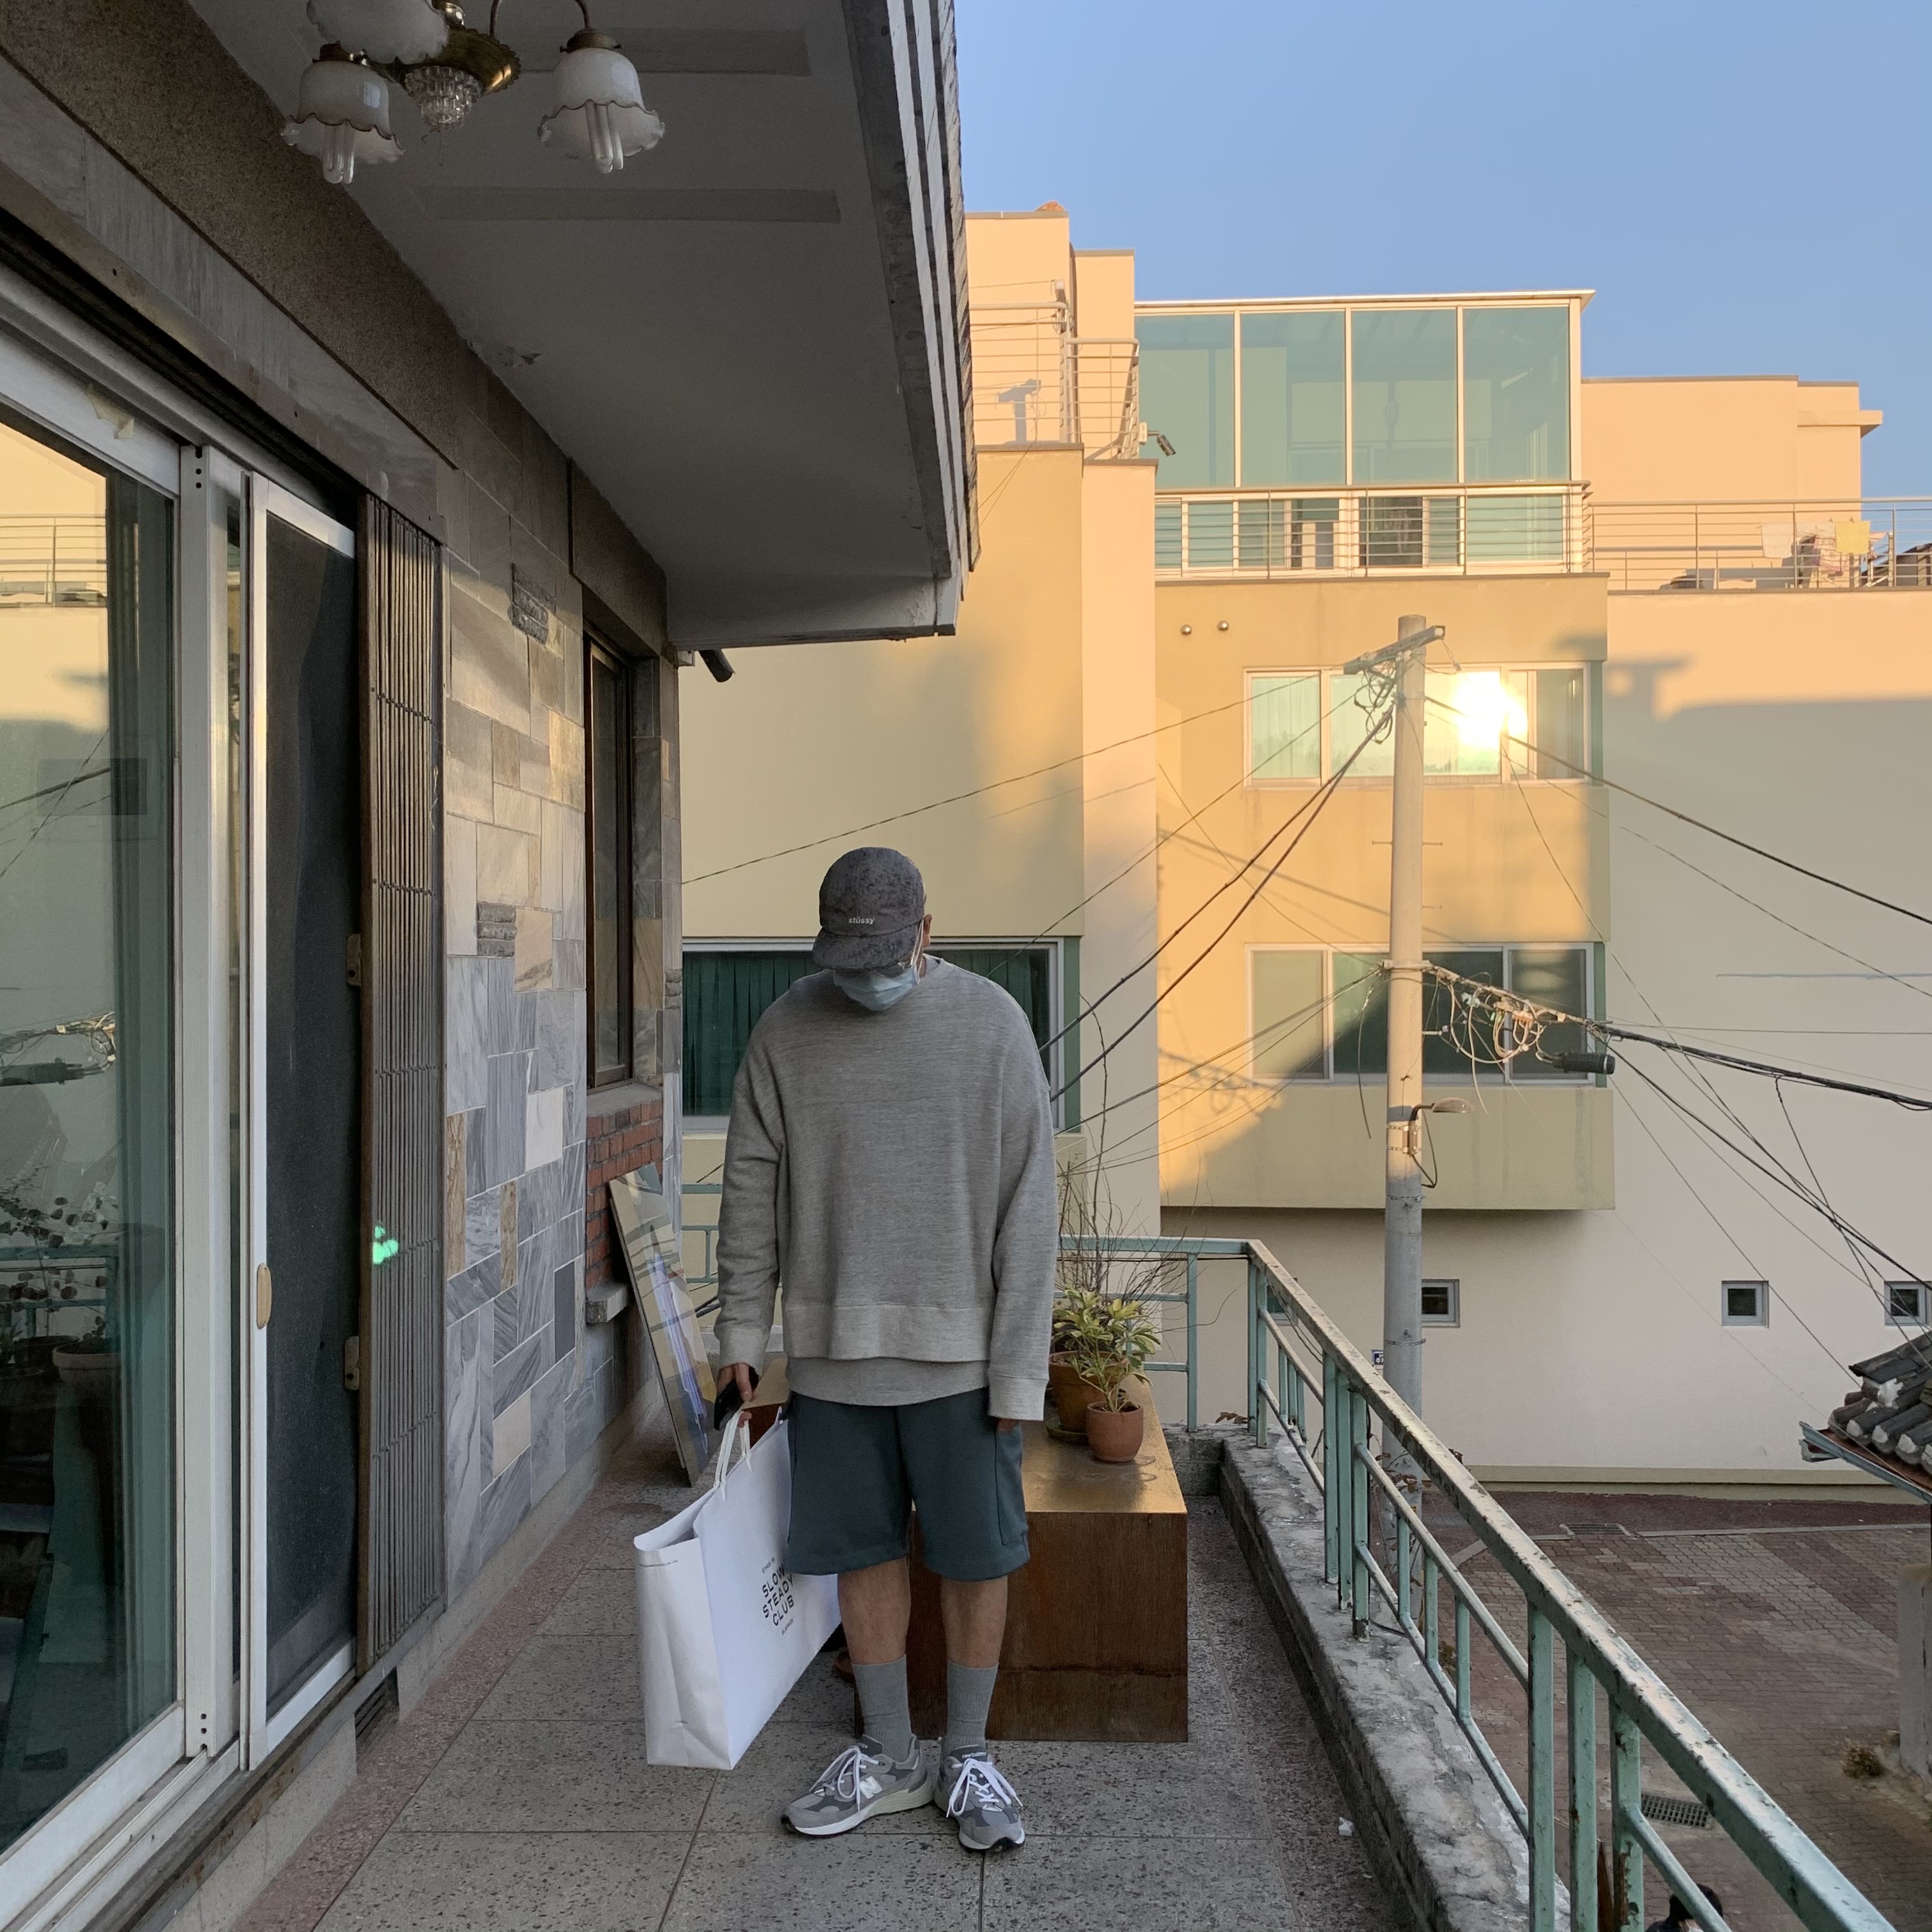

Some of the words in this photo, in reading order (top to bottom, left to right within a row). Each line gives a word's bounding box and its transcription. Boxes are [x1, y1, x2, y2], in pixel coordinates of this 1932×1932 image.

[762, 1564, 785, 1598] SLOW
[763, 1574, 793, 1618] STEADY
[772, 1595, 794, 1627] CLUB
[859, 1775, 882, 1799] N
